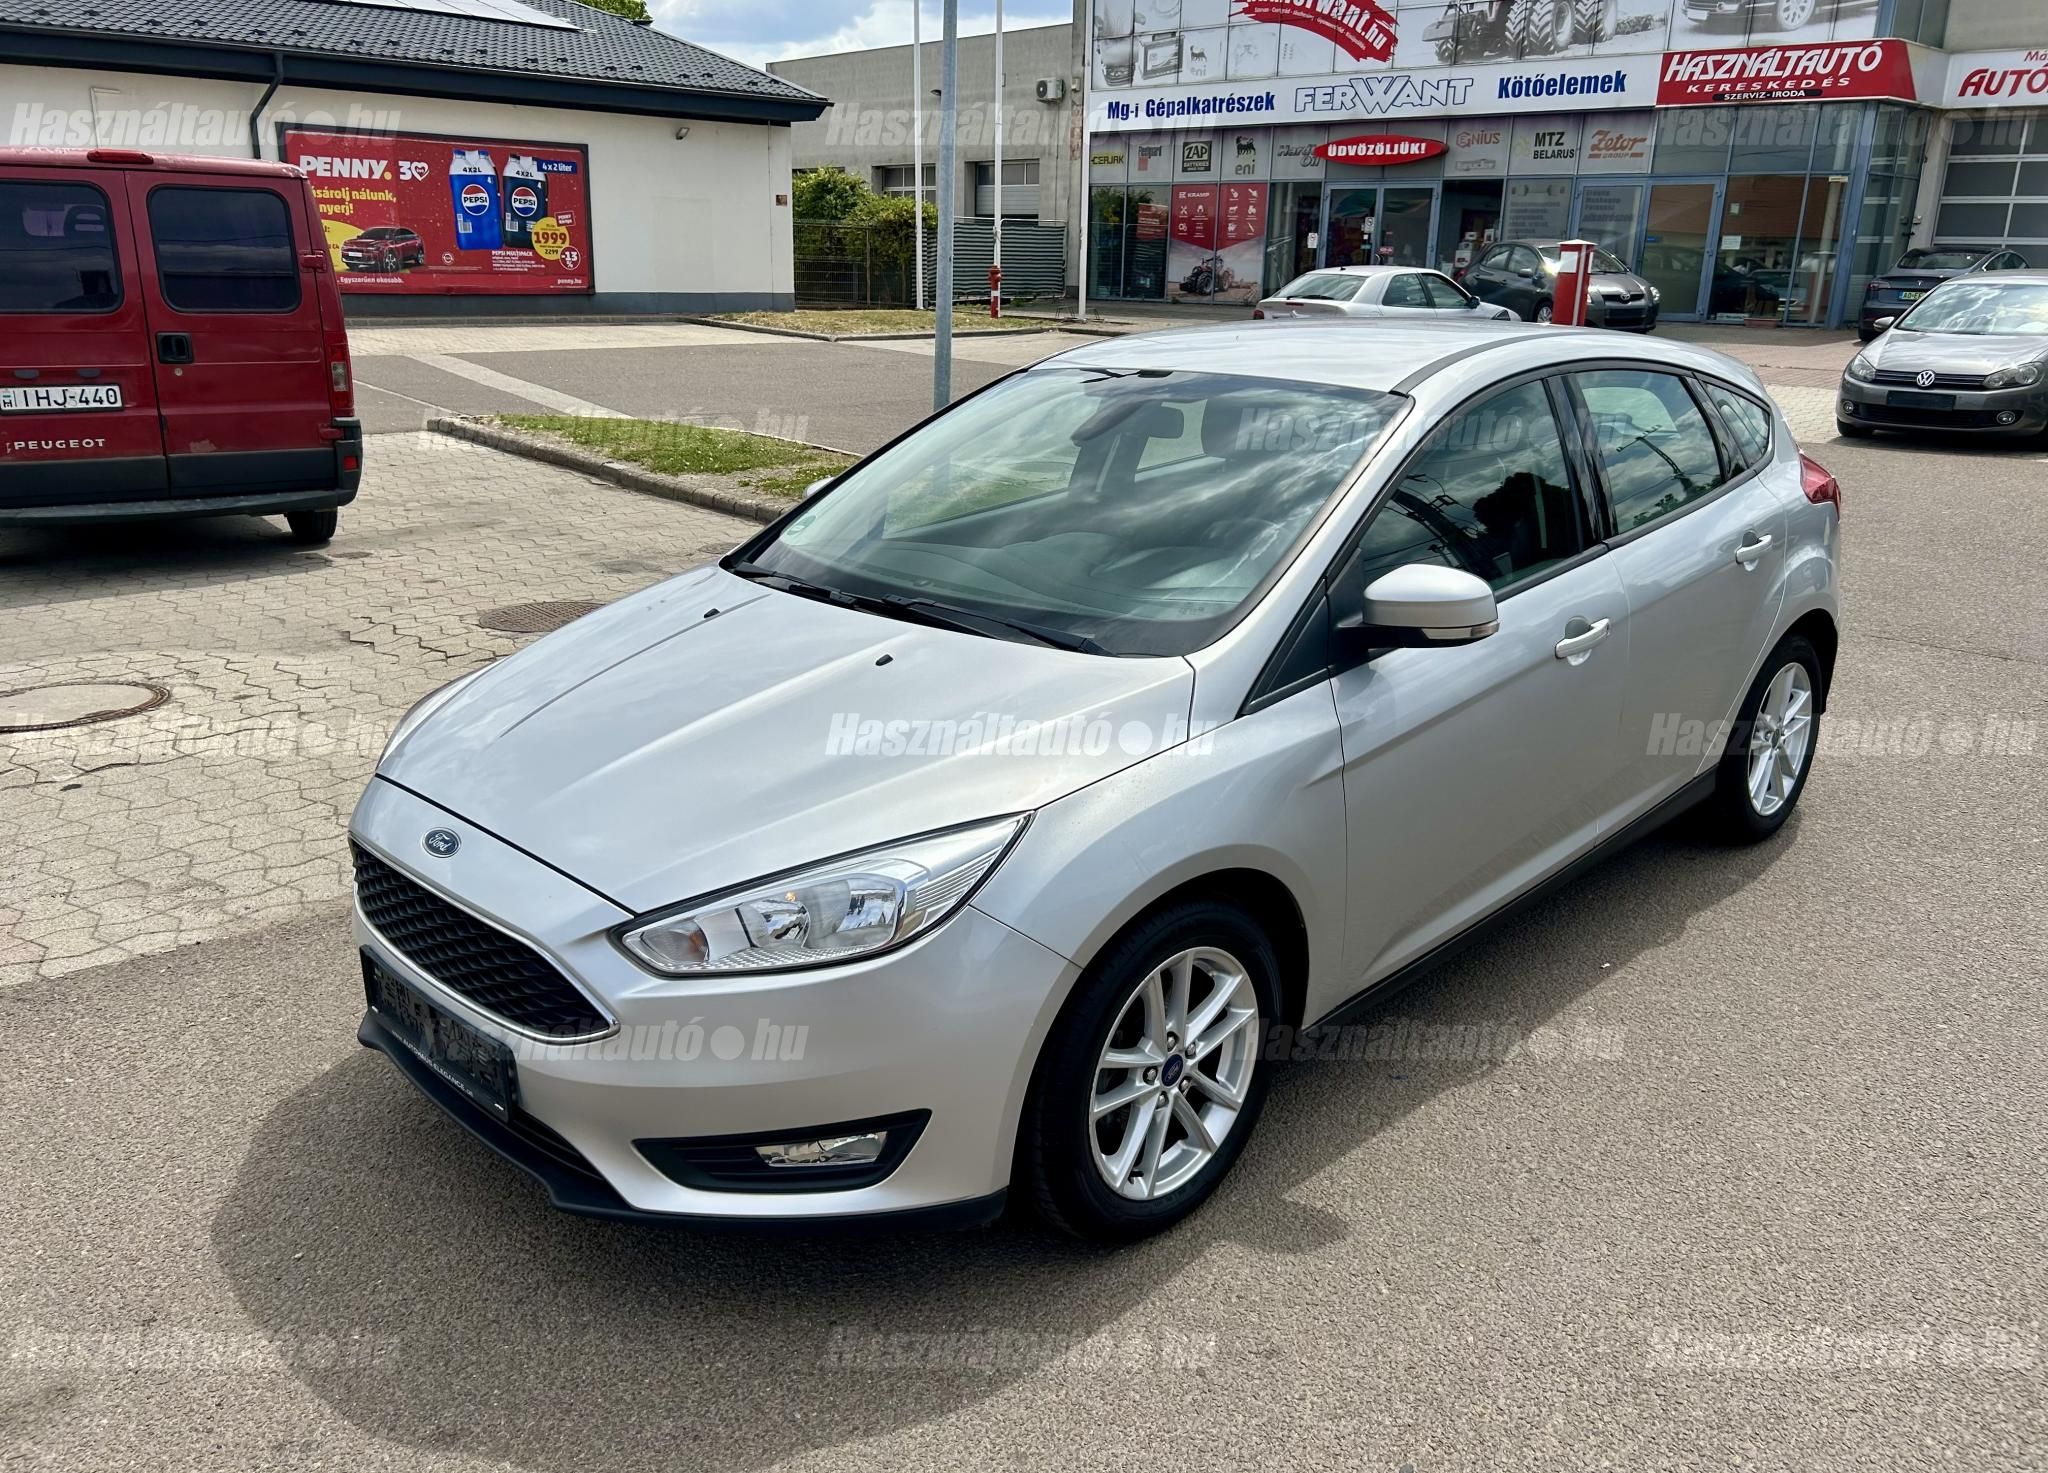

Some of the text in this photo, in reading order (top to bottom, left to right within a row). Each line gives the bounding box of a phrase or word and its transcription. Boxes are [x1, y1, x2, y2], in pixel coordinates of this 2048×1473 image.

[1664, 42, 1883, 82] HASZNÁLTAUTÓ
[2024, 50, 2048, 62] Má
[1498, 70, 1628, 99] Kötőelemek
[1687, 77, 1850, 94] KERESKEDÉS
[1295, 75, 1474, 114] FERWANT
[1107, 91, 1276, 121] Mg-i Gépalkatrészek
[1534, 132, 1565, 147] MTZ
[1591, 129, 1647, 151] Zetor
[1185, 145, 1208, 159] ZAP
[1327, 142, 1426, 156] ÜDVÖZÖLJÜK!
[1533, 148, 1575, 159] BELARUS
[1234, 160, 1255, 175] eni
[311, 186, 397, 203] ásárolj nálunk,
[534, 232, 567, 244] 1999
[14, 439, 105, 450] PEUGEOT
